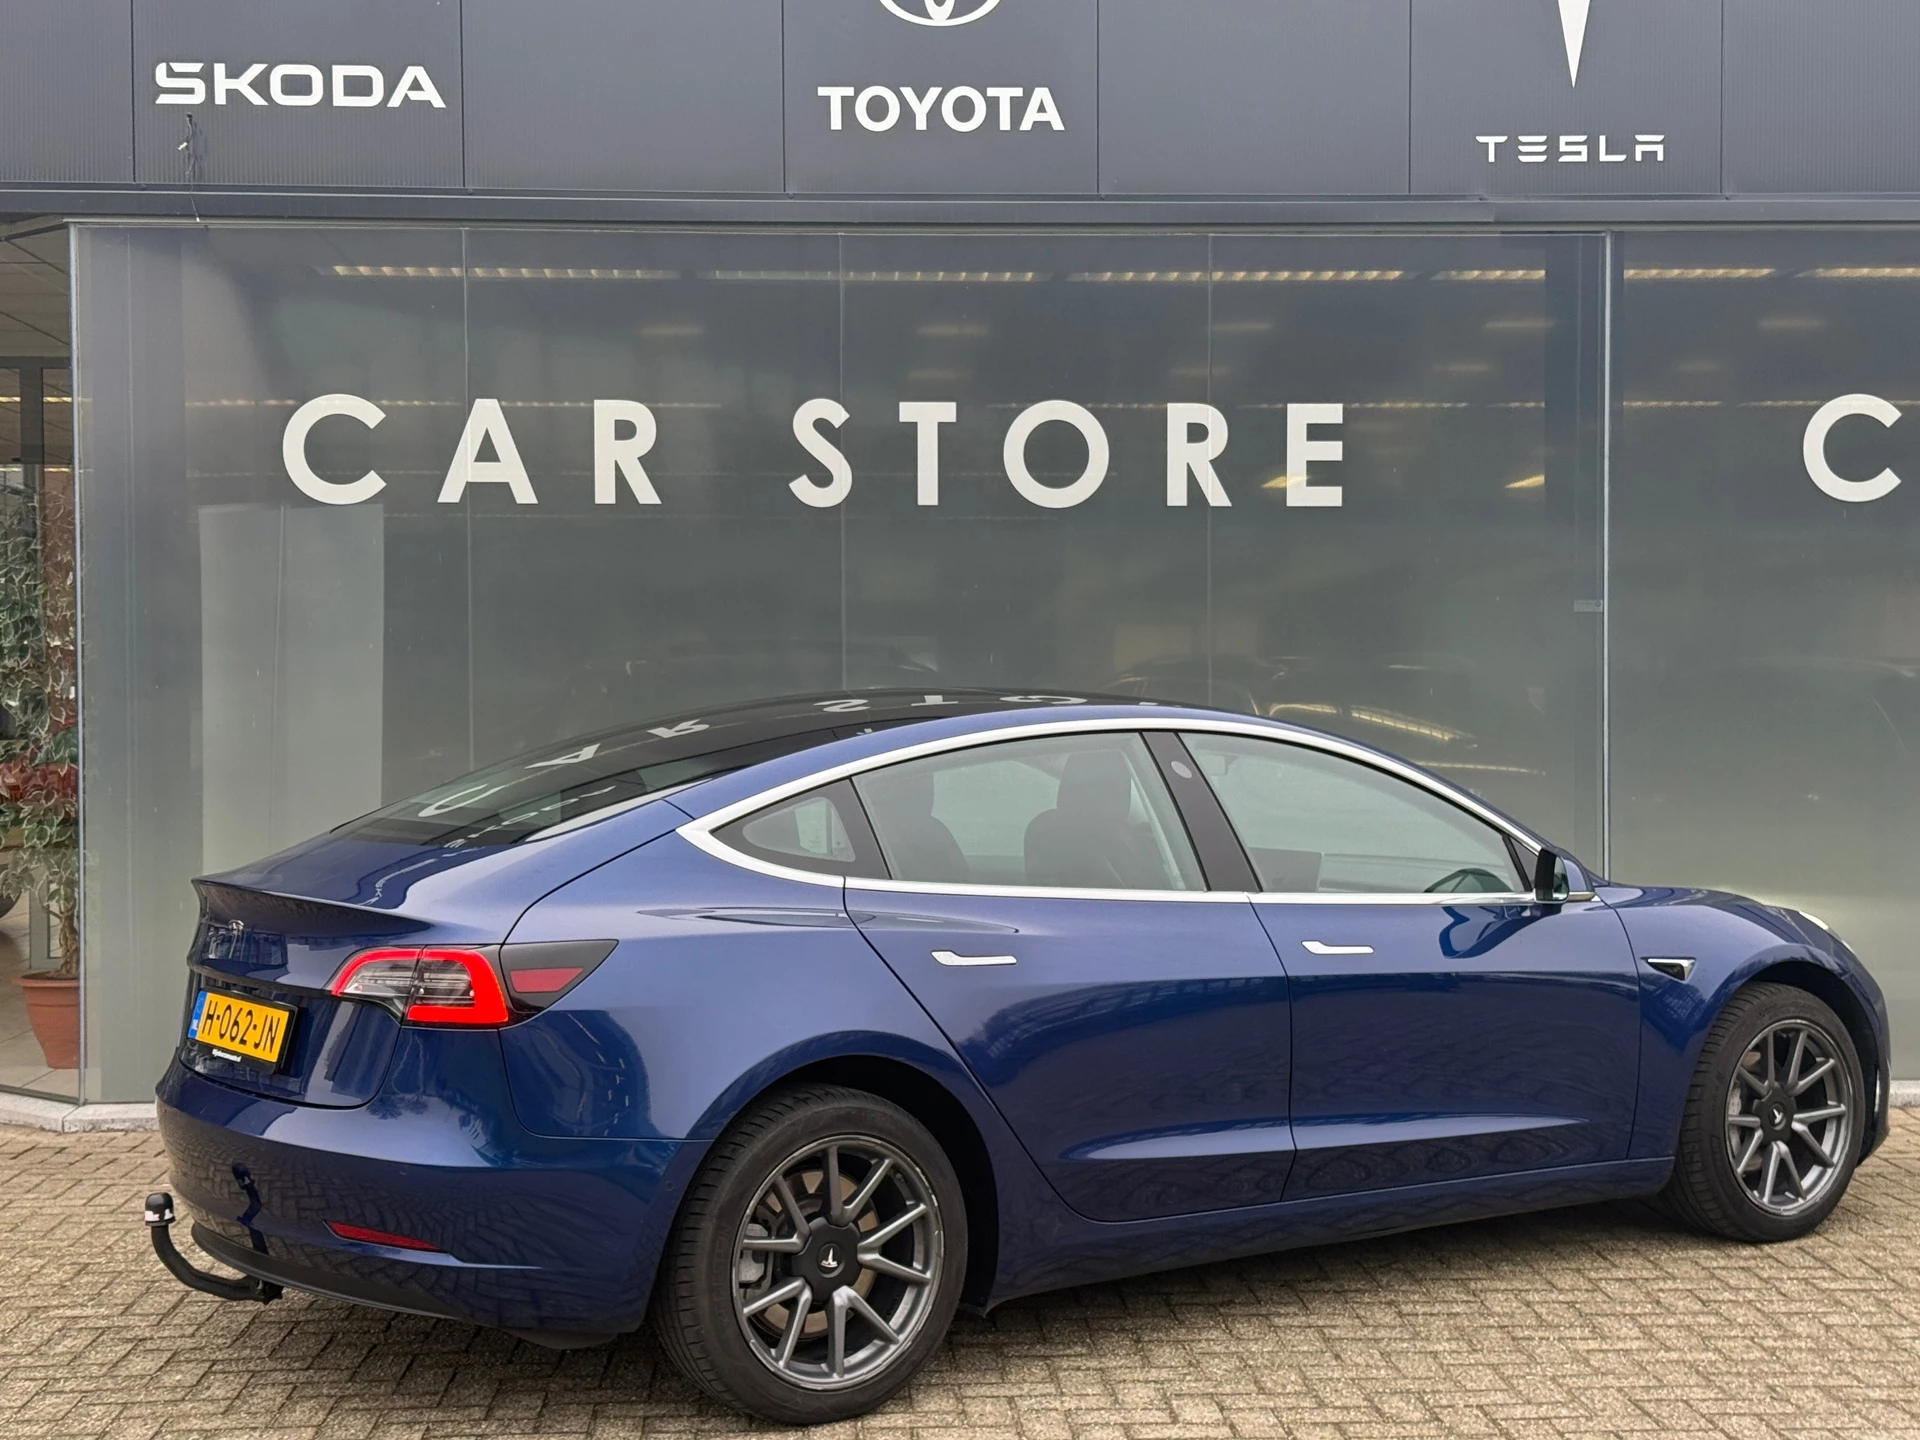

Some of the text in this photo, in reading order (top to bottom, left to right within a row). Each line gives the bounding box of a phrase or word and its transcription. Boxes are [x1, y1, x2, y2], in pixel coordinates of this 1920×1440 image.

[817, 86, 1065, 132] TOYOTA
[1476, 134, 1665, 163] TESLA
[282, 393, 1344, 509] CAR STORE
[201, 999, 281, 1054] H-062-JN
